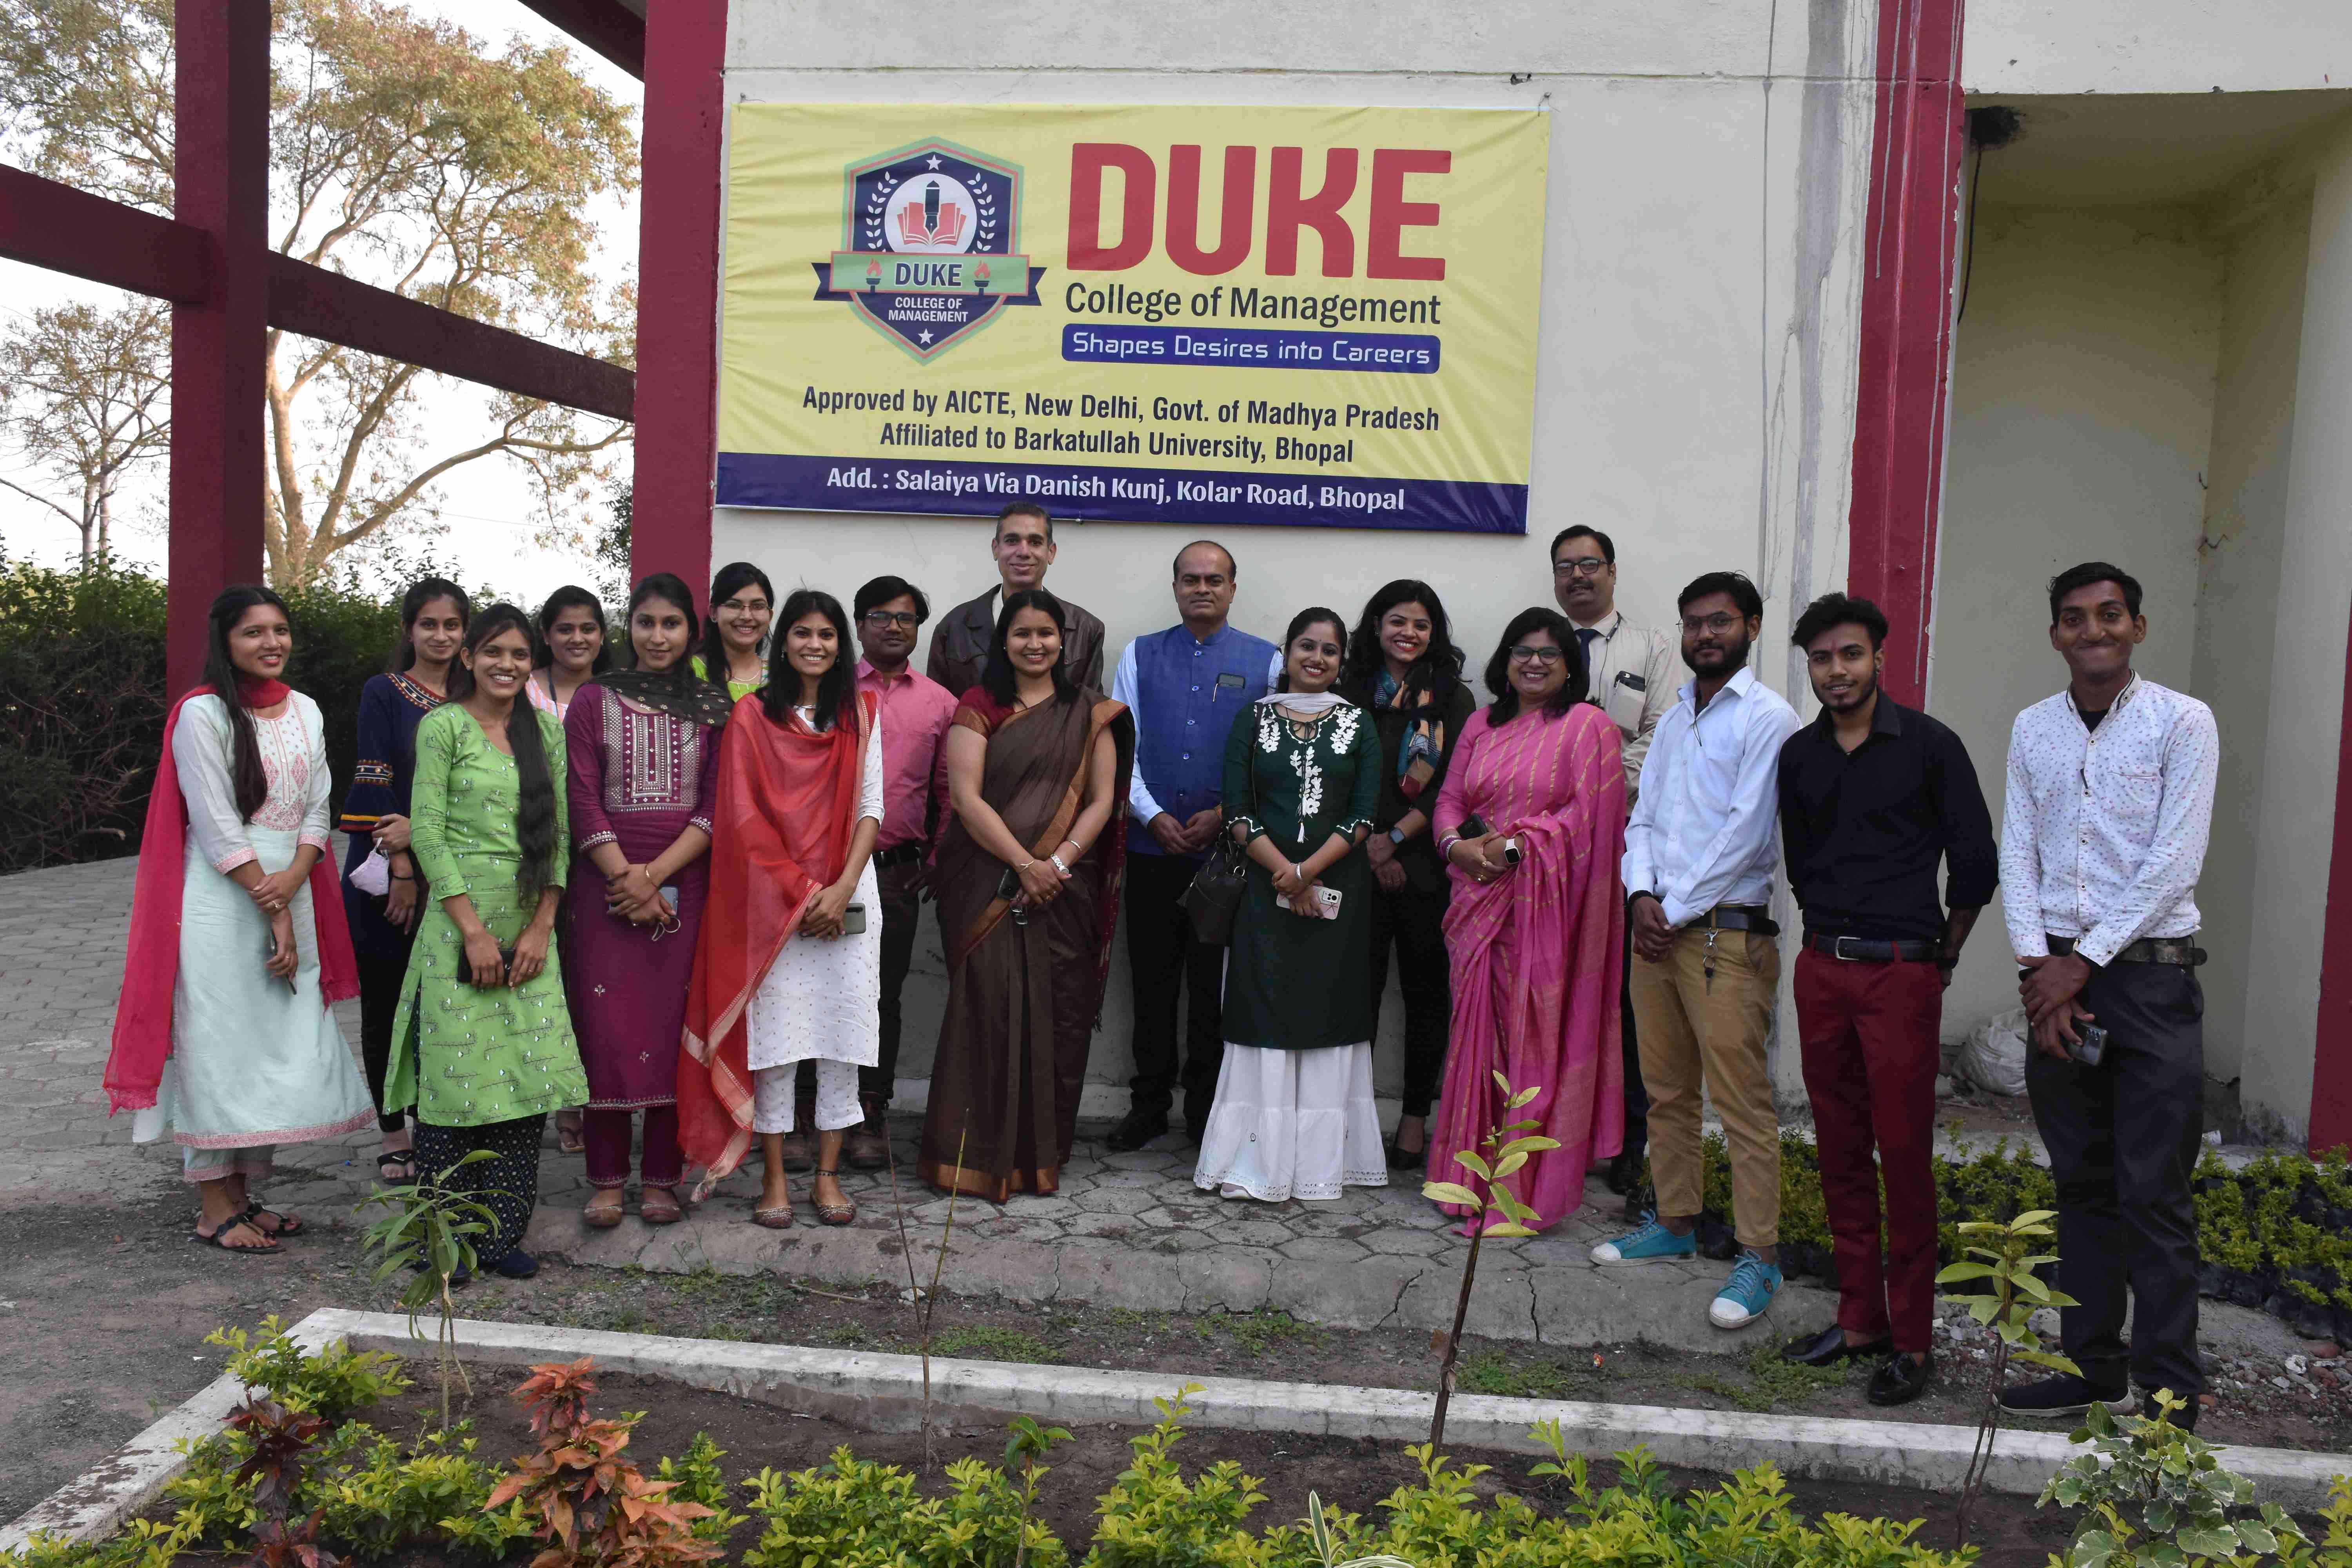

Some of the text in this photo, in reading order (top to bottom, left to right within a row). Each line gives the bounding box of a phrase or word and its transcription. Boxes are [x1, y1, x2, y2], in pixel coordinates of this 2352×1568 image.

[1067, 143, 1452, 281] DUKE
[895, 263, 962, 287] DUKE
[888, 310, 968, 322] MANAGEMENT
[895, 297, 963, 309] COLLEGE OF
[1066, 282, 1441, 328] College of Management
[1073, 332, 1430, 364] Shapes Desires into Careers
[803, 386, 1439, 431] Approved by AICTE, New Delhi, Govt. of Madhya Pradesh
[880, 423, 1353, 467] Affiliated to Barkatullah University, Bhopal
[827, 467, 877, 488] Add.
[895, 470, 978, 496] Salaiya
[984, 472, 1019, 494] Via
[1025, 475, 1105, 497] Danish
[1112, 478, 1171, 505] Kunj,
[1177, 481, 1242, 503] Kolar
[1247, 484, 1314, 509] Road,
[1320, 486, 1404, 514] Bhopal
